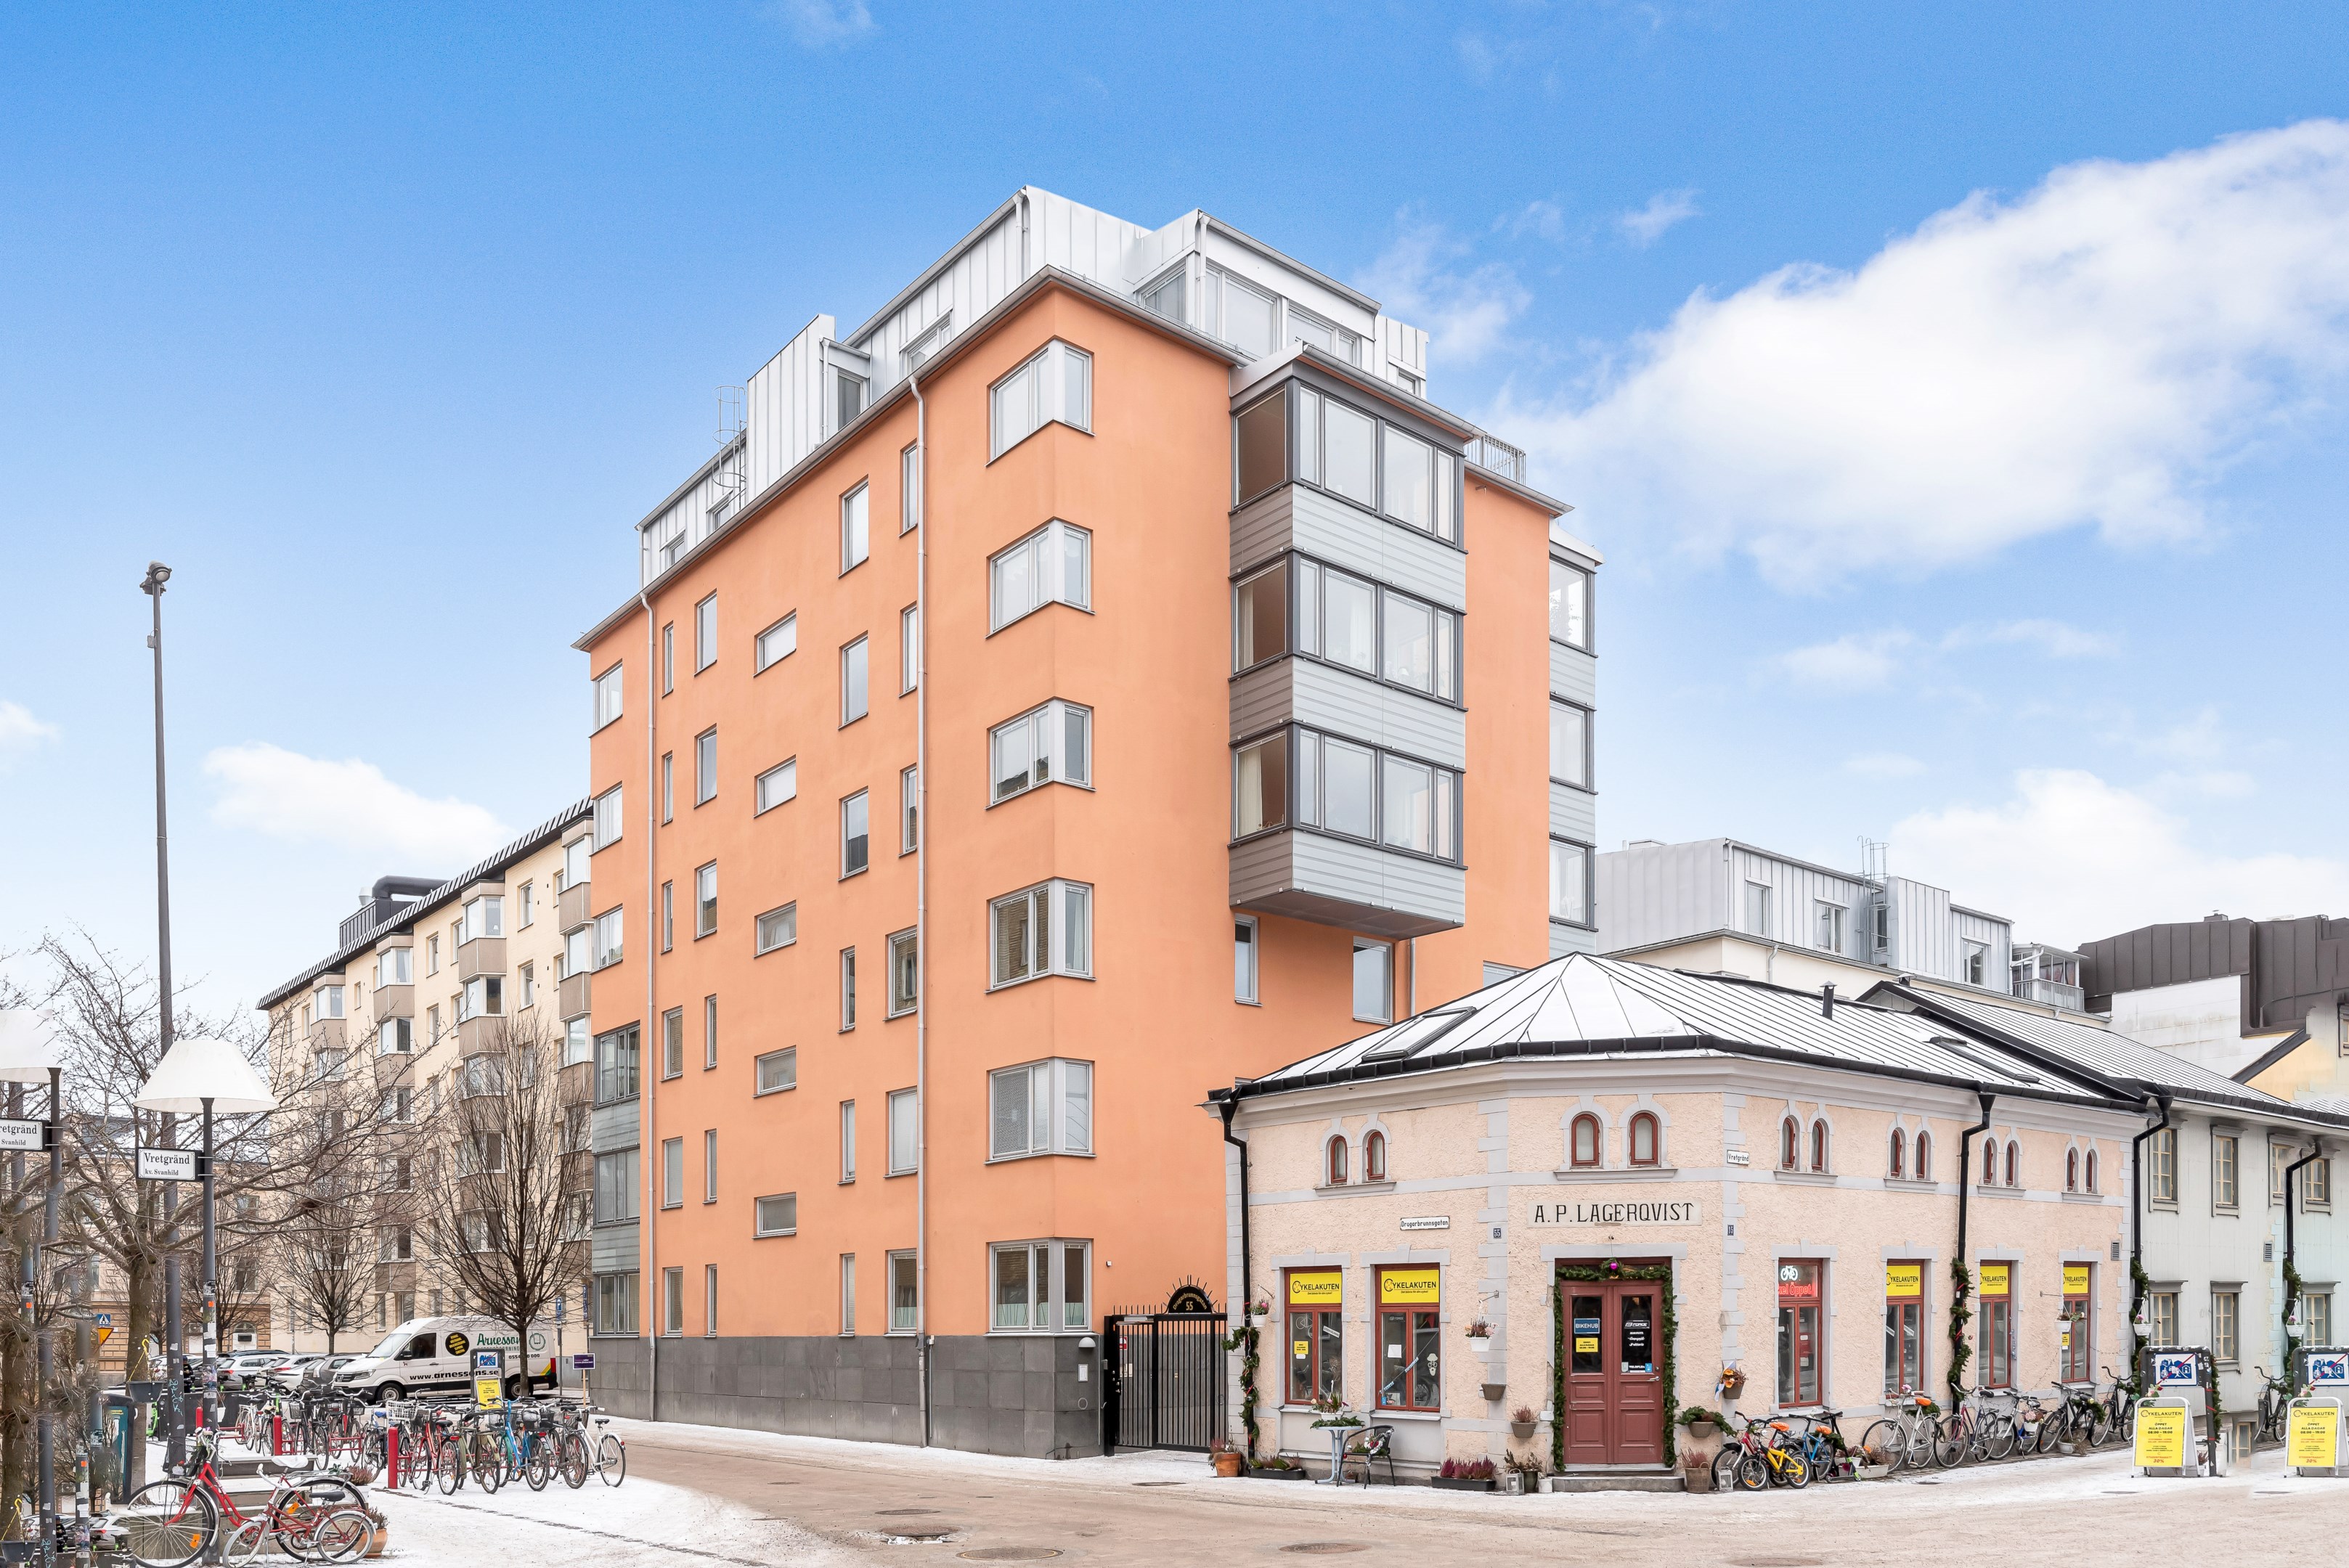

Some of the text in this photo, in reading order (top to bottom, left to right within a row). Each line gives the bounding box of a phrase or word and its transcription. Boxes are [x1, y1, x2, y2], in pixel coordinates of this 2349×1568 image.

[0, 1124, 37, 1135] etgränd
[144, 1152, 190, 1166] Vretgränd
[1728, 1153, 1749, 1162] Vretgränd
[1401, 1220, 1449, 1228] Dragarbrunnsgatan
[1494, 1229, 1501, 1238] 55
[1186, 1301, 1194, 1311] 55
